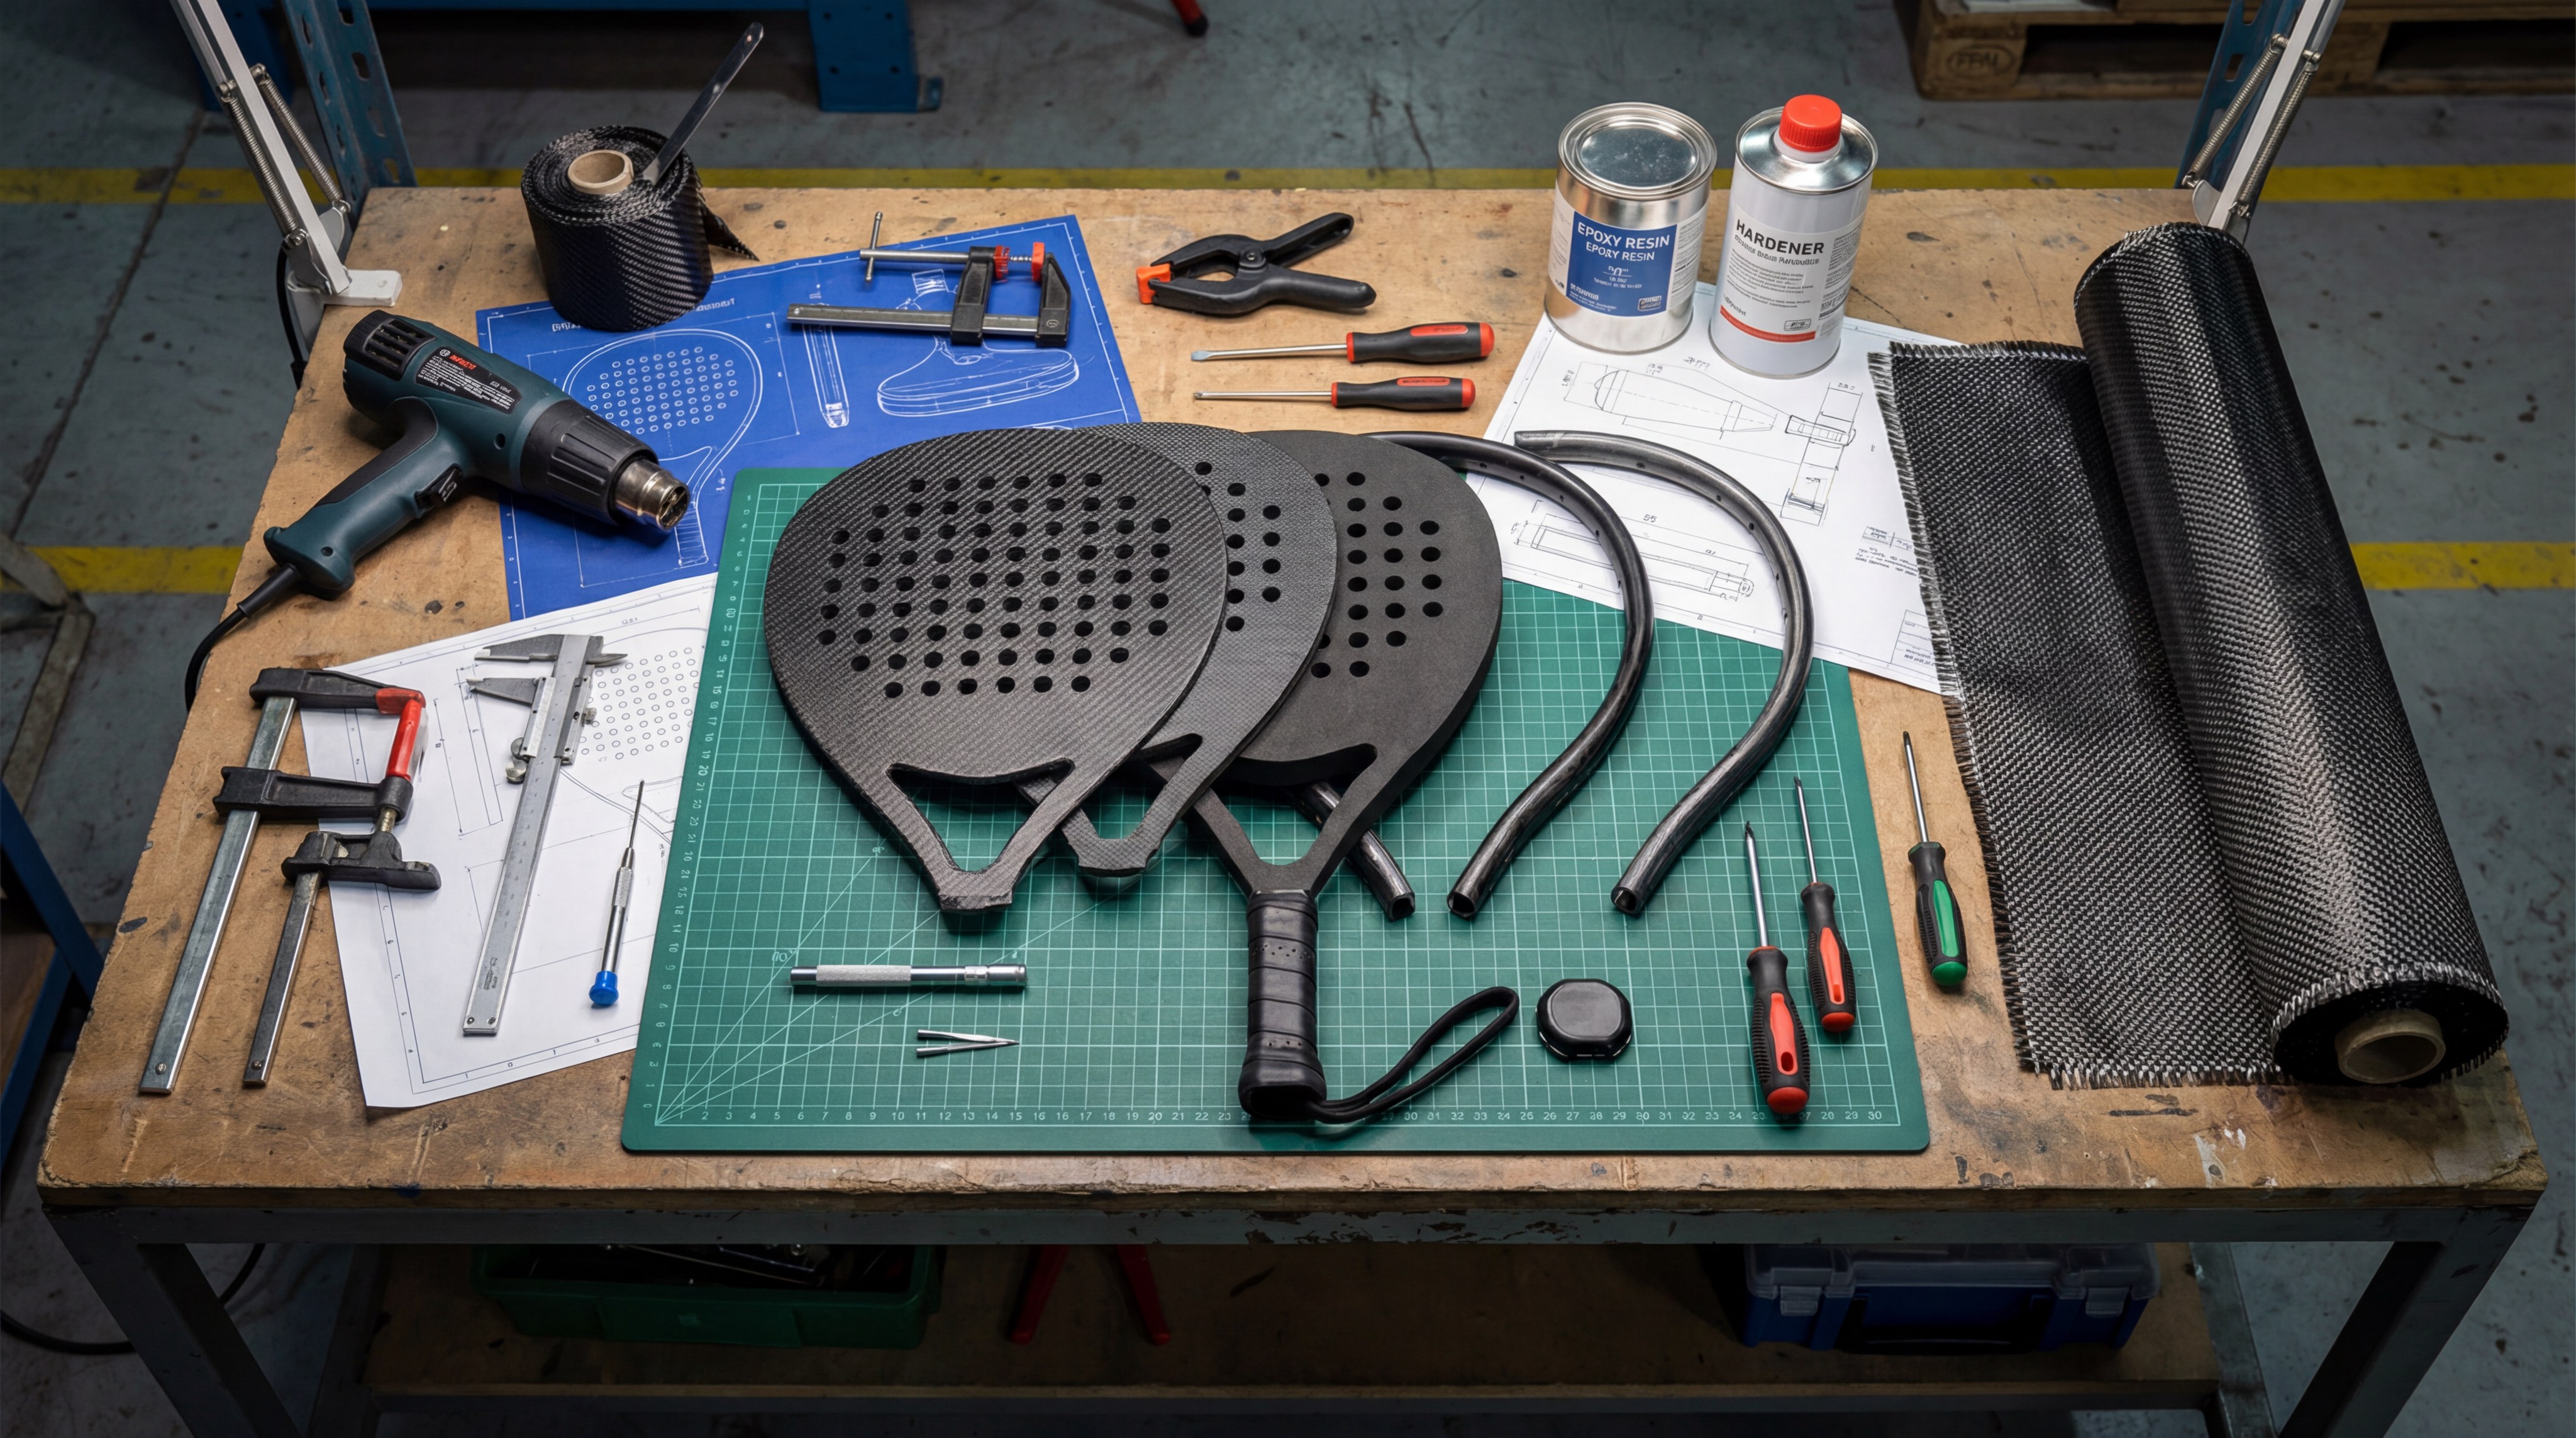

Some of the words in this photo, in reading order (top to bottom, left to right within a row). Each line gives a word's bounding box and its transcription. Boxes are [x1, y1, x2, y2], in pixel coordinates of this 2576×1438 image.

[1577, 221, 1622, 247] EPOXY
[1625, 235, 1670, 249] RESIN
[1736, 219, 1824, 255] HARDENER
[1622, 252, 1655, 262] RESIN
[698, 765, 709, 776] 20
[680, 869, 691, 878] 21
[669, 943, 679, 952] 10
[701, 1111, 709, 1120] 2
[725, 1112, 732, 1120] 3
[750, 1112, 756, 1120] 4
[774, 1112, 780, 1120] 5
[797, 1112, 804, 1120] 6
[822, 1112, 829, 1120] 7
[845, 1112, 852, 1120] 8
[869, 1112, 877, 1120] 9
[892, 1112, 905, 1120] 10
[916, 1112, 926, 1120] 11
[940, 1112, 952, 1120] 12
[962, 1112, 975, 1120] 13
[986, 1112, 998, 1120] 14
[1010, 1112, 1023, 1121] 15
[1034, 1112, 1046, 1121] 16
[1057, 1112, 1069, 1120] 16
[1080, 1112, 1092, 1121] 17
[1103, 1112, 1116, 1120] 18
[1127, 1112, 1139, 1120] 19
[1148, 1112, 1162, 1121] 20
[1172, 1112, 1184, 1120] 21
[1195, 1112, 1209, 1120] 22
[1520, 1112, 1534, 1120] 26
[1543, 1112, 1557, 1121] 26
[1566, 1112, 1580, 1121] 27
[1613, 1111, 1626, 1120] 29
